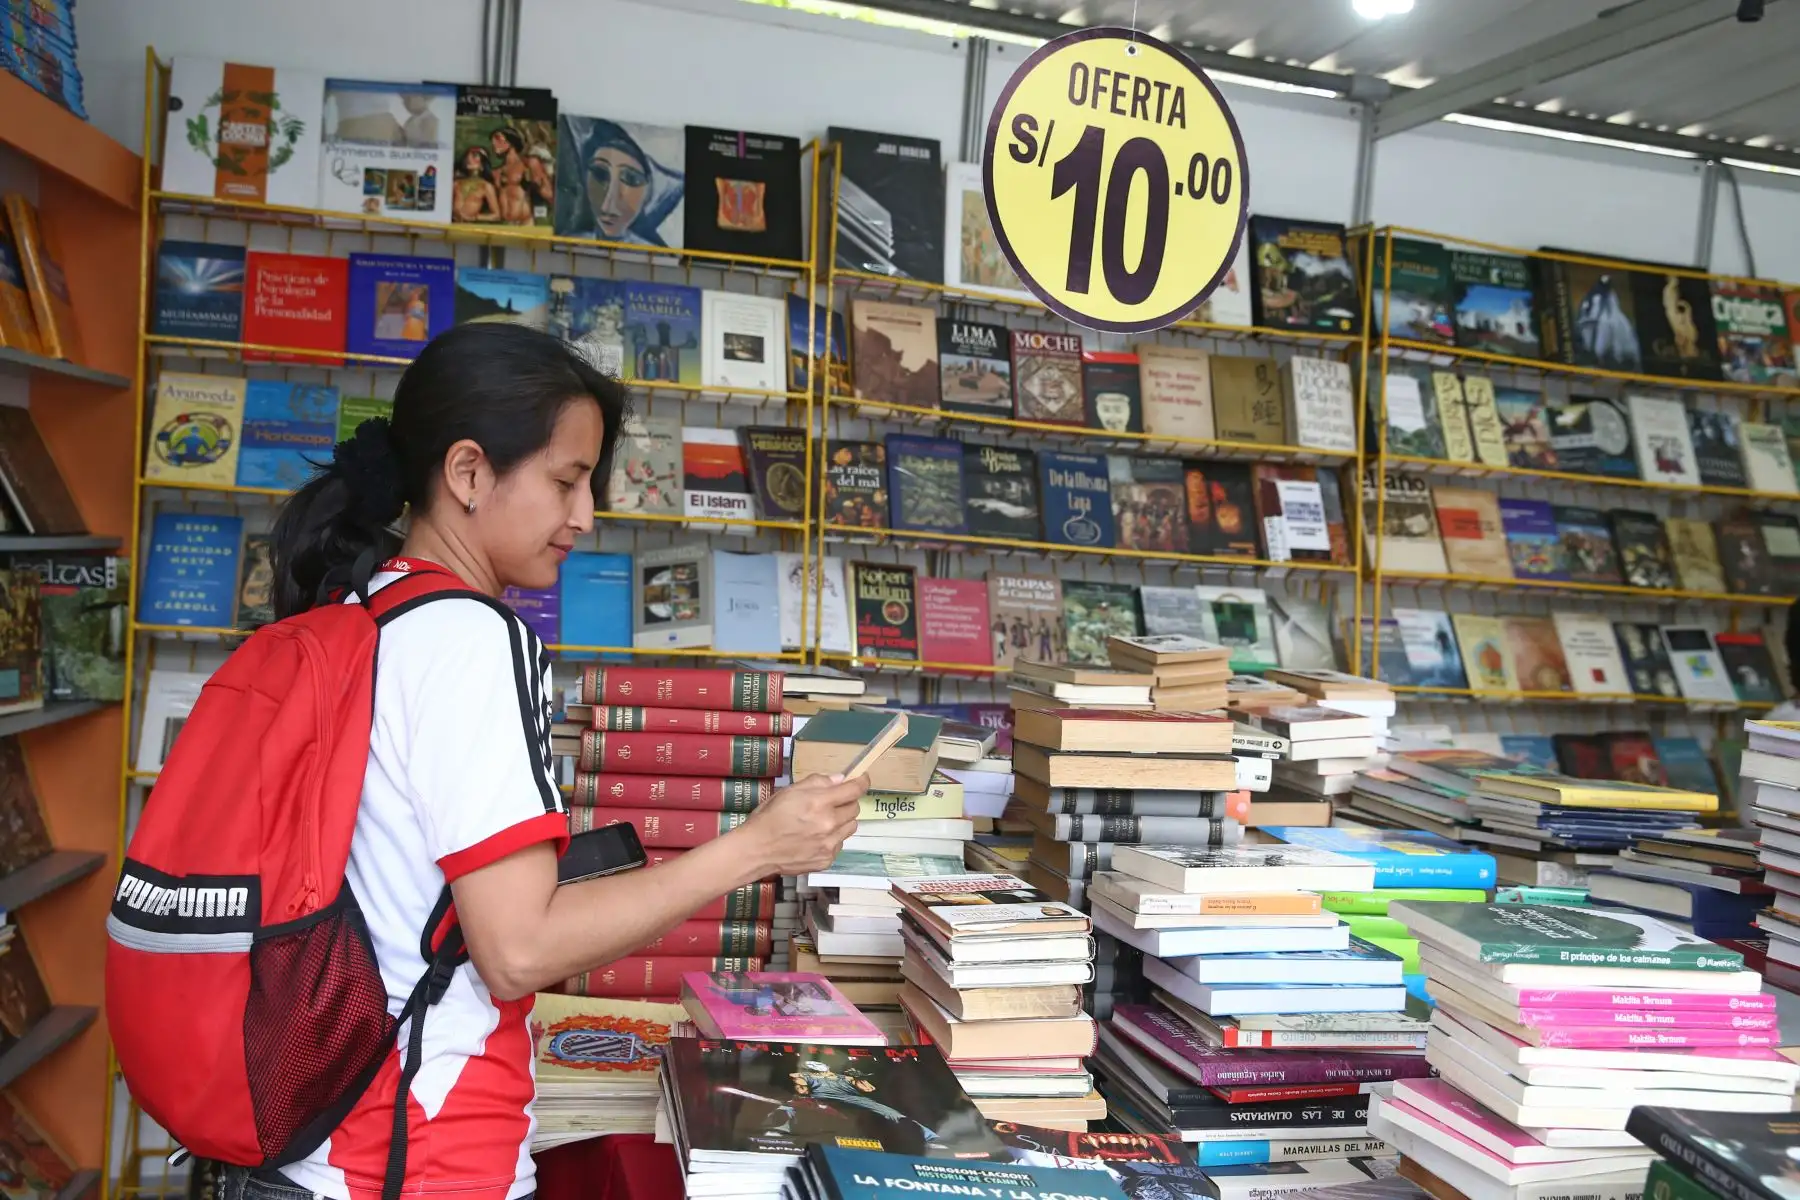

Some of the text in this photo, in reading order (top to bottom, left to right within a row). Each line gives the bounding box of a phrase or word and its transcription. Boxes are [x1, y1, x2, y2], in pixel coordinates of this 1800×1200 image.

[1068, 62, 1187, 130] OFERTA
[325, 144, 439, 162] Primeros auxilios
[314, 273, 330, 286] de
[628, 292, 682, 306] LA CRUZ
[254, 304, 332, 323] Personalidad
[628, 302, 691, 318] AMARILLA
[951, 323, 996, 341] LIMA
[1014, 332, 1080, 353] MOCHE
[162, 385, 237, 403] Ayurveda
[836, 474, 881, 489] del mal
[691, 493, 747, 510] El Islam
[176, 522, 219, 533] DESDE
[187, 535, 204, 544] LA
[155, 545, 233, 557] ETERNIDAD
[170, 557, 215, 567] HASTA
[996, 576, 1055, 591] TROPAS
[169, 590, 207, 600] SEAN
[154, 601, 219, 613] CARROLL
[1231, 737, 1246, 746] Corsa
[698, 749, 709, 760] IX
[874, 796, 916, 820] Inglés
[685, 822, 695, 834] IV
[1560, 951, 1569, 961] El
[1569, 952, 1608, 965] príncipe
[1608, 953, 1618, 963] de
[1619, 953, 1632, 963] los
[1632, 955, 1671, 966] caimanes
[1612, 994, 1764, 1009] Maldita Ternura Planeta
[1614, 1013, 1643, 1024] Maldita
[1645, 1014, 1676, 1025] Ternura
[1629, 1034, 1770, 1045] Maldita Ternura Planeta
[1217, 1066, 1286, 1083] Karlos Arguiñano
[1325, 1067, 1393, 1078] EL MENÚ DE CADA DÍA
[1230, 1110, 1293, 1122] OLIMPIADAS
[1302, 1109, 1323, 1120] LAS
[1331, 1109, 1346, 1120] DE
[1234, 1149, 1254, 1158] DISNEY
[1283, 1141, 1386, 1157] MARAVILLAS DEL MAR
[914, 1164, 1030, 1182] BOURGEON-LACROIX
[916, 1171, 1037, 1189] HISTORIA DE CYANN (1)
[853, 1173, 1036, 1200] LA FONTANA Y LA
[1249, 1186, 1272, 1200] Galega
